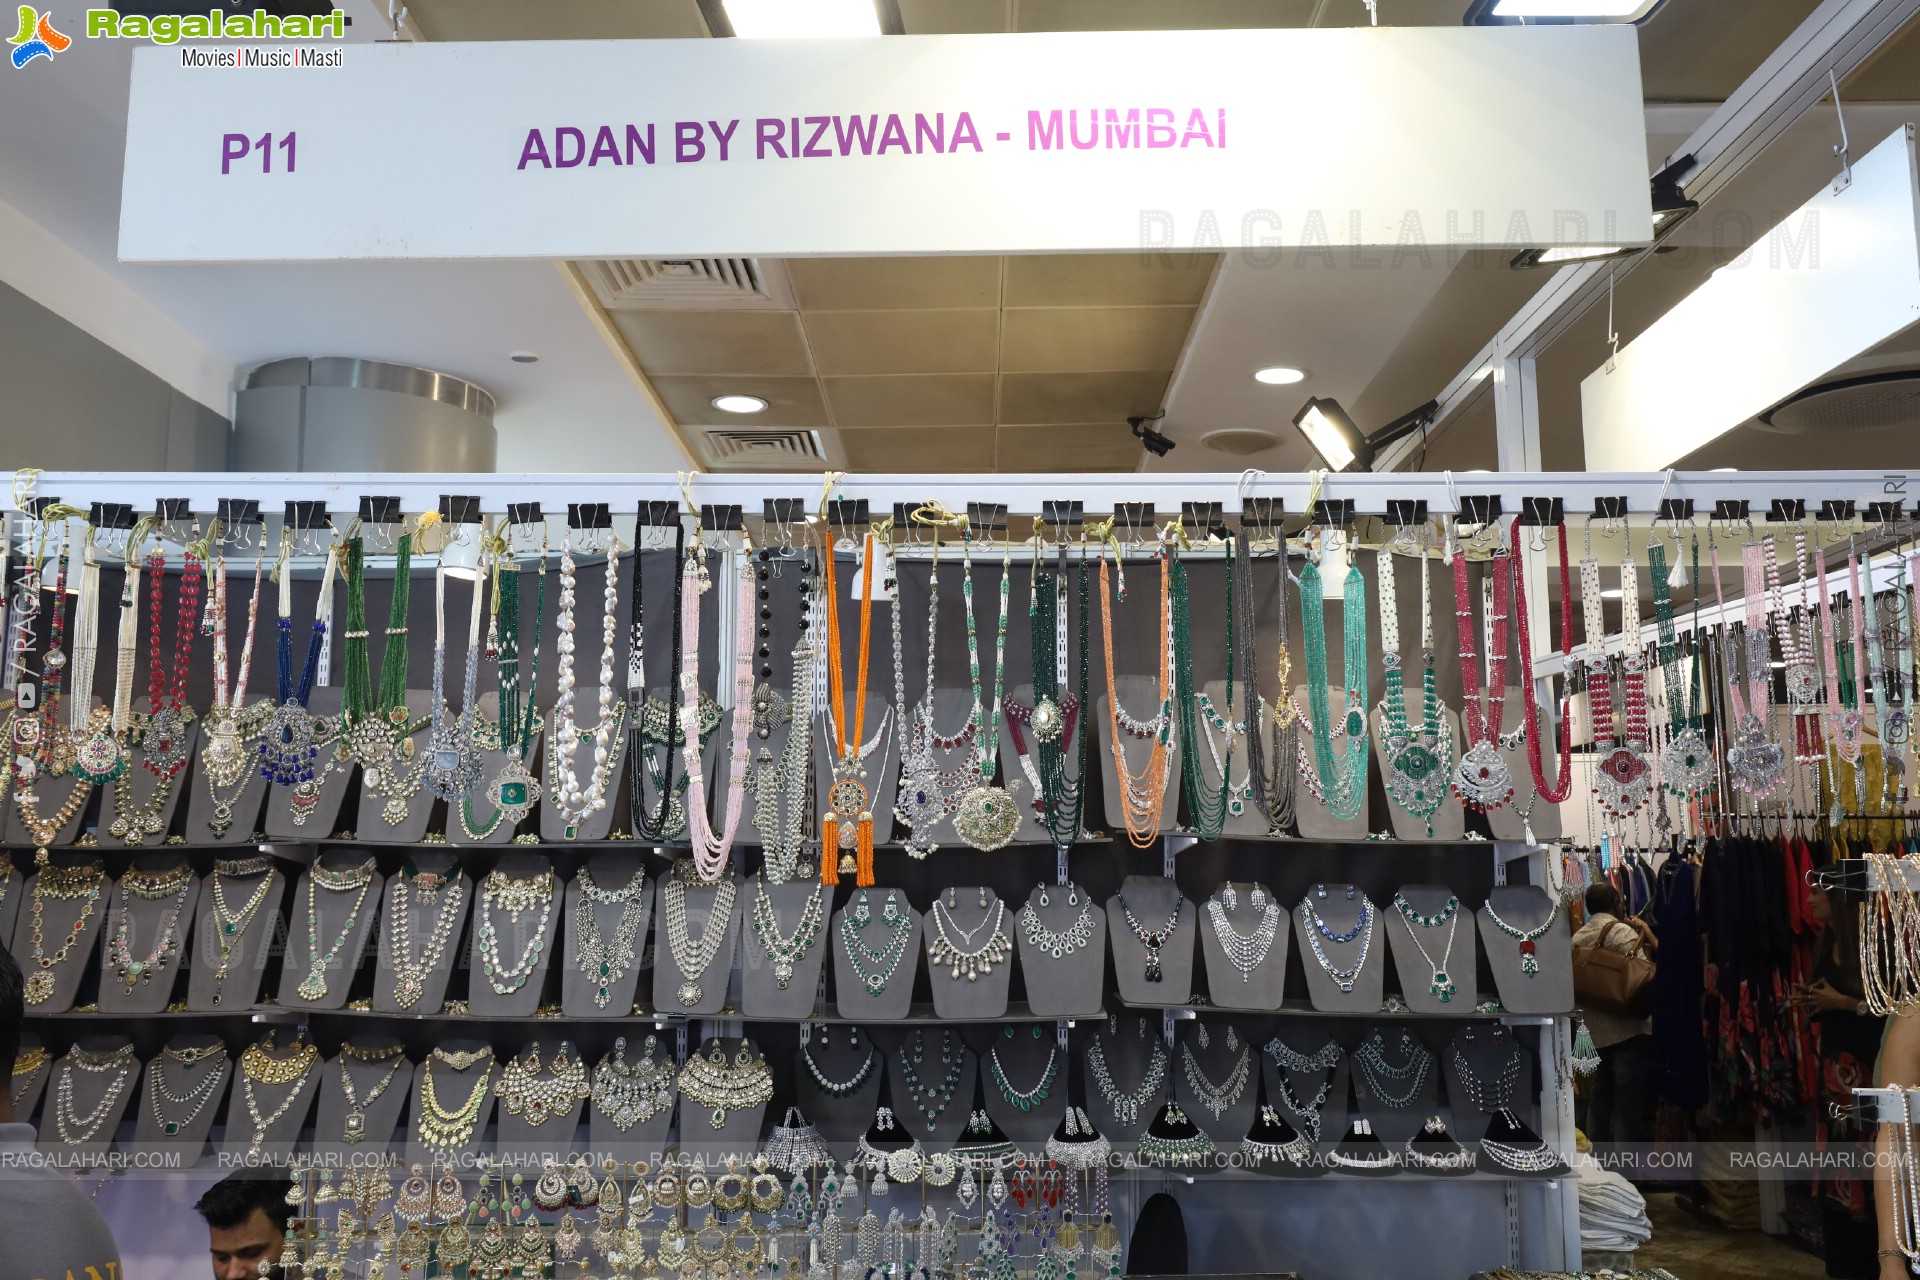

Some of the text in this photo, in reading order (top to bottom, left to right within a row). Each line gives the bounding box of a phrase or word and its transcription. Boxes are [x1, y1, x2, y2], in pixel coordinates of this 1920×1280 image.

[221, 132, 298, 175] P11
[517, 123, 656, 170] ADAN
[675, 119, 740, 163] BY
[756, 111, 984, 160] RIZWANA
[1027, 108, 1226, 150] MUMBAI
